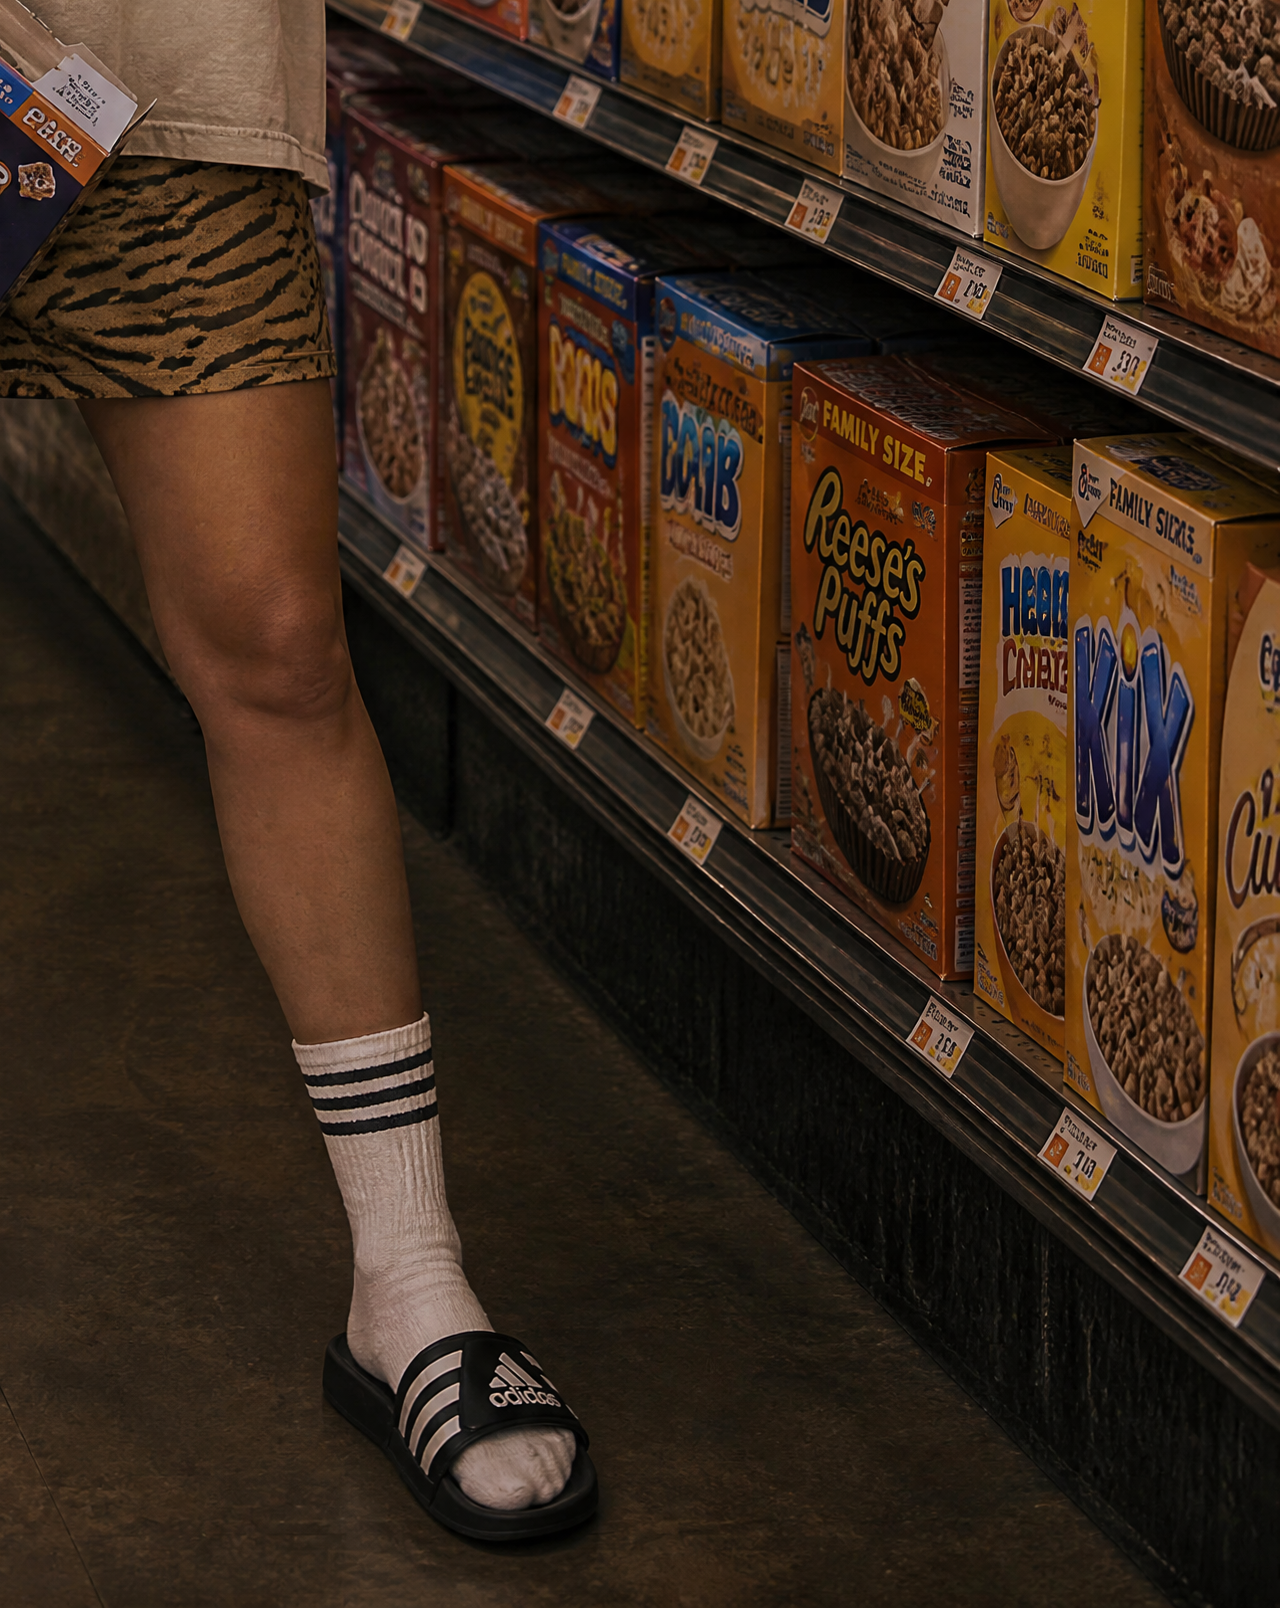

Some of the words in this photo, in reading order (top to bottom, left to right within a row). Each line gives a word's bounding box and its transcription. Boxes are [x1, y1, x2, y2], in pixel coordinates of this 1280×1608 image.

[822, 398, 880, 457] FAMILY
[804, 469, 926, 614] Reese's
[813, 562, 905, 681] Puffs
[488, 1385, 562, 1408] adidas
